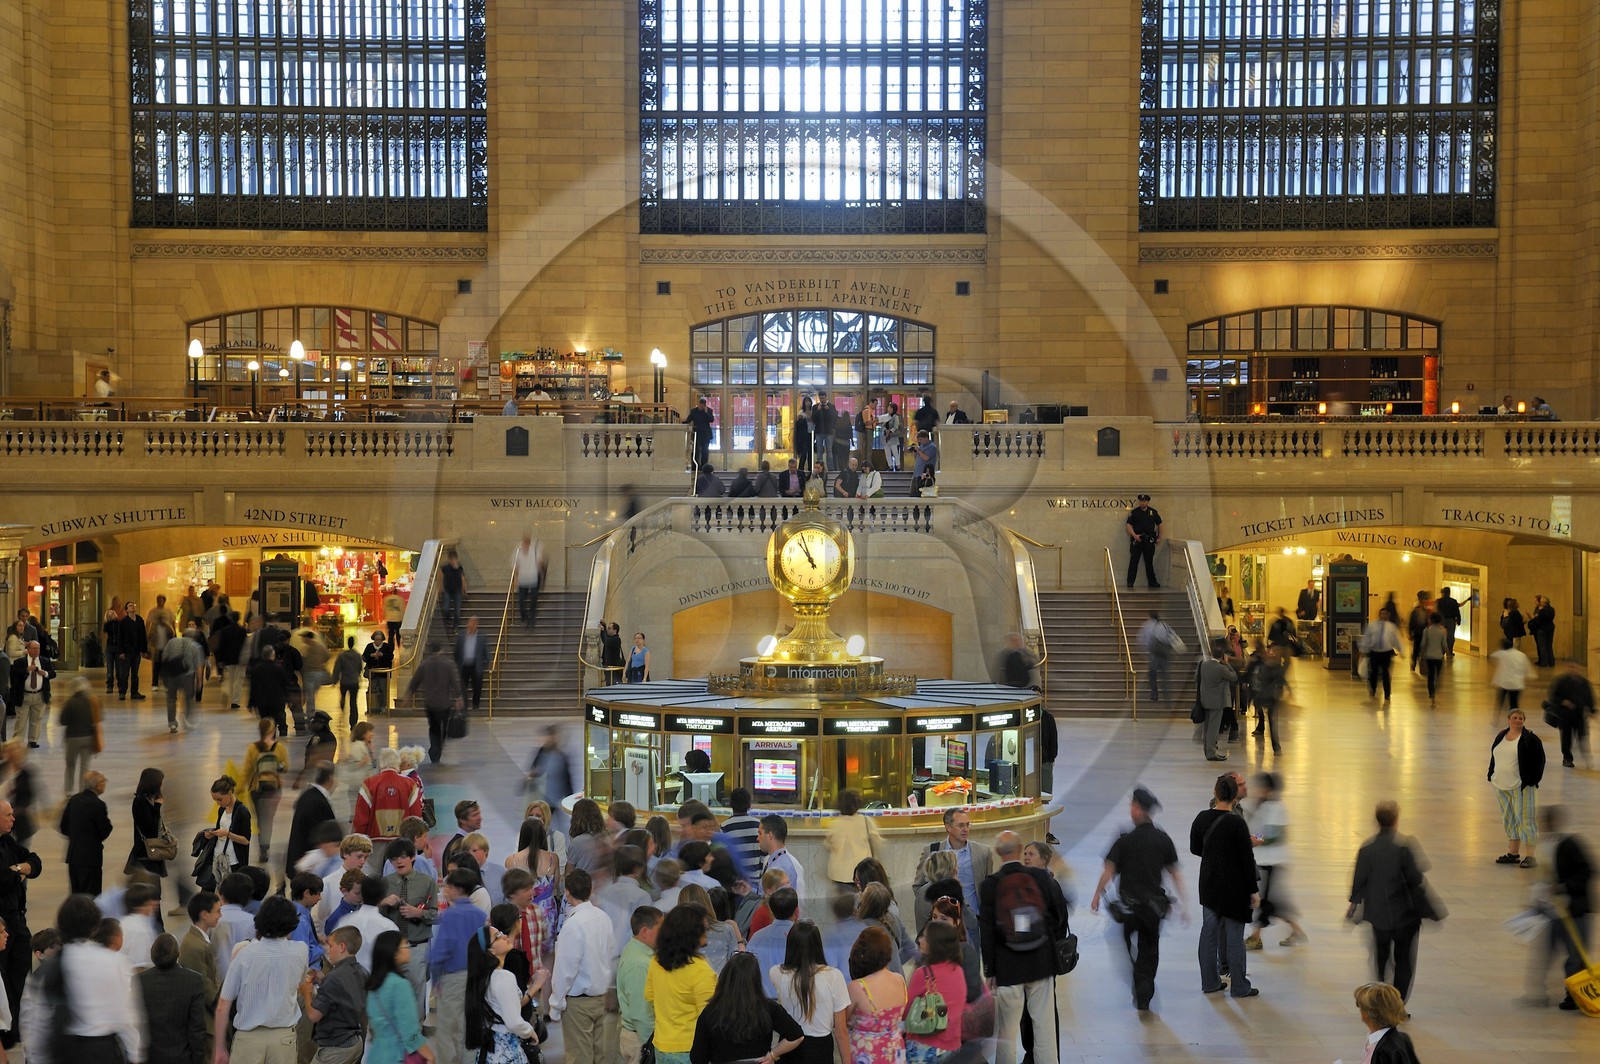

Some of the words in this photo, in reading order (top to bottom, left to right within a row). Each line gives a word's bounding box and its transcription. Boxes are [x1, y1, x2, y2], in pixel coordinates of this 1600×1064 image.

[716, 286, 736, 299] TO
[744, 279, 841, 293] VANDERBILT
[850, 281, 911, 299] AVENUE
[705, 300, 736, 315] THE
[744, 292, 822, 307] CAMPBELL
[832, 292, 922, 315] APARTMENT
[209, 339, 252, 354] IPRIANI
[490, 498, 522, 508] WEST
[525, 498, 580, 508] BALCONY
[1046, 499, 1079, 508] WEST
[1081, 499, 1136, 508] BALCONY
[41, 513, 108, 537] SUBWAY
[113, 508, 186, 525] SHUTTLE
[244, 509, 286, 522] 42ND
[289, 512, 348, 529] STREET
[1240, 517, 1295, 537] TICKET
[1302, 508, 1385, 527] MACHINES
[1442, 508, 1505, 525] TRACKS
[1508, 515, 1522, 527] 31
[1528, 517, 1550, 531] TO
[1553, 523, 1570, 535] 42
[222, 533, 279, 547] SUBWAY
[282, 532, 343, 543] SHUTTLE
[807, 534, 815, 543] 12
[1337, 531, 1397, 546] WAITING
[1403, 537, 1444, 551] ROOM
[787, 557, 792, 565] 9
[790, 568, 796, 576] 8
[828, 567, 833, 575] 4
[797, 575, 803, 583] 7
[808, 577, 814, 585] 6
[819, 575, 825, 583] 5
[678, 586, 718, 606] DINING
[885, 582, 900, 592] 100
[902, 585, 916, 596] TO
[917, 590, 930, 600] 117
[786, 665, 857, 679] Information
[688, 718, 724, 726] METRO-NORTH
